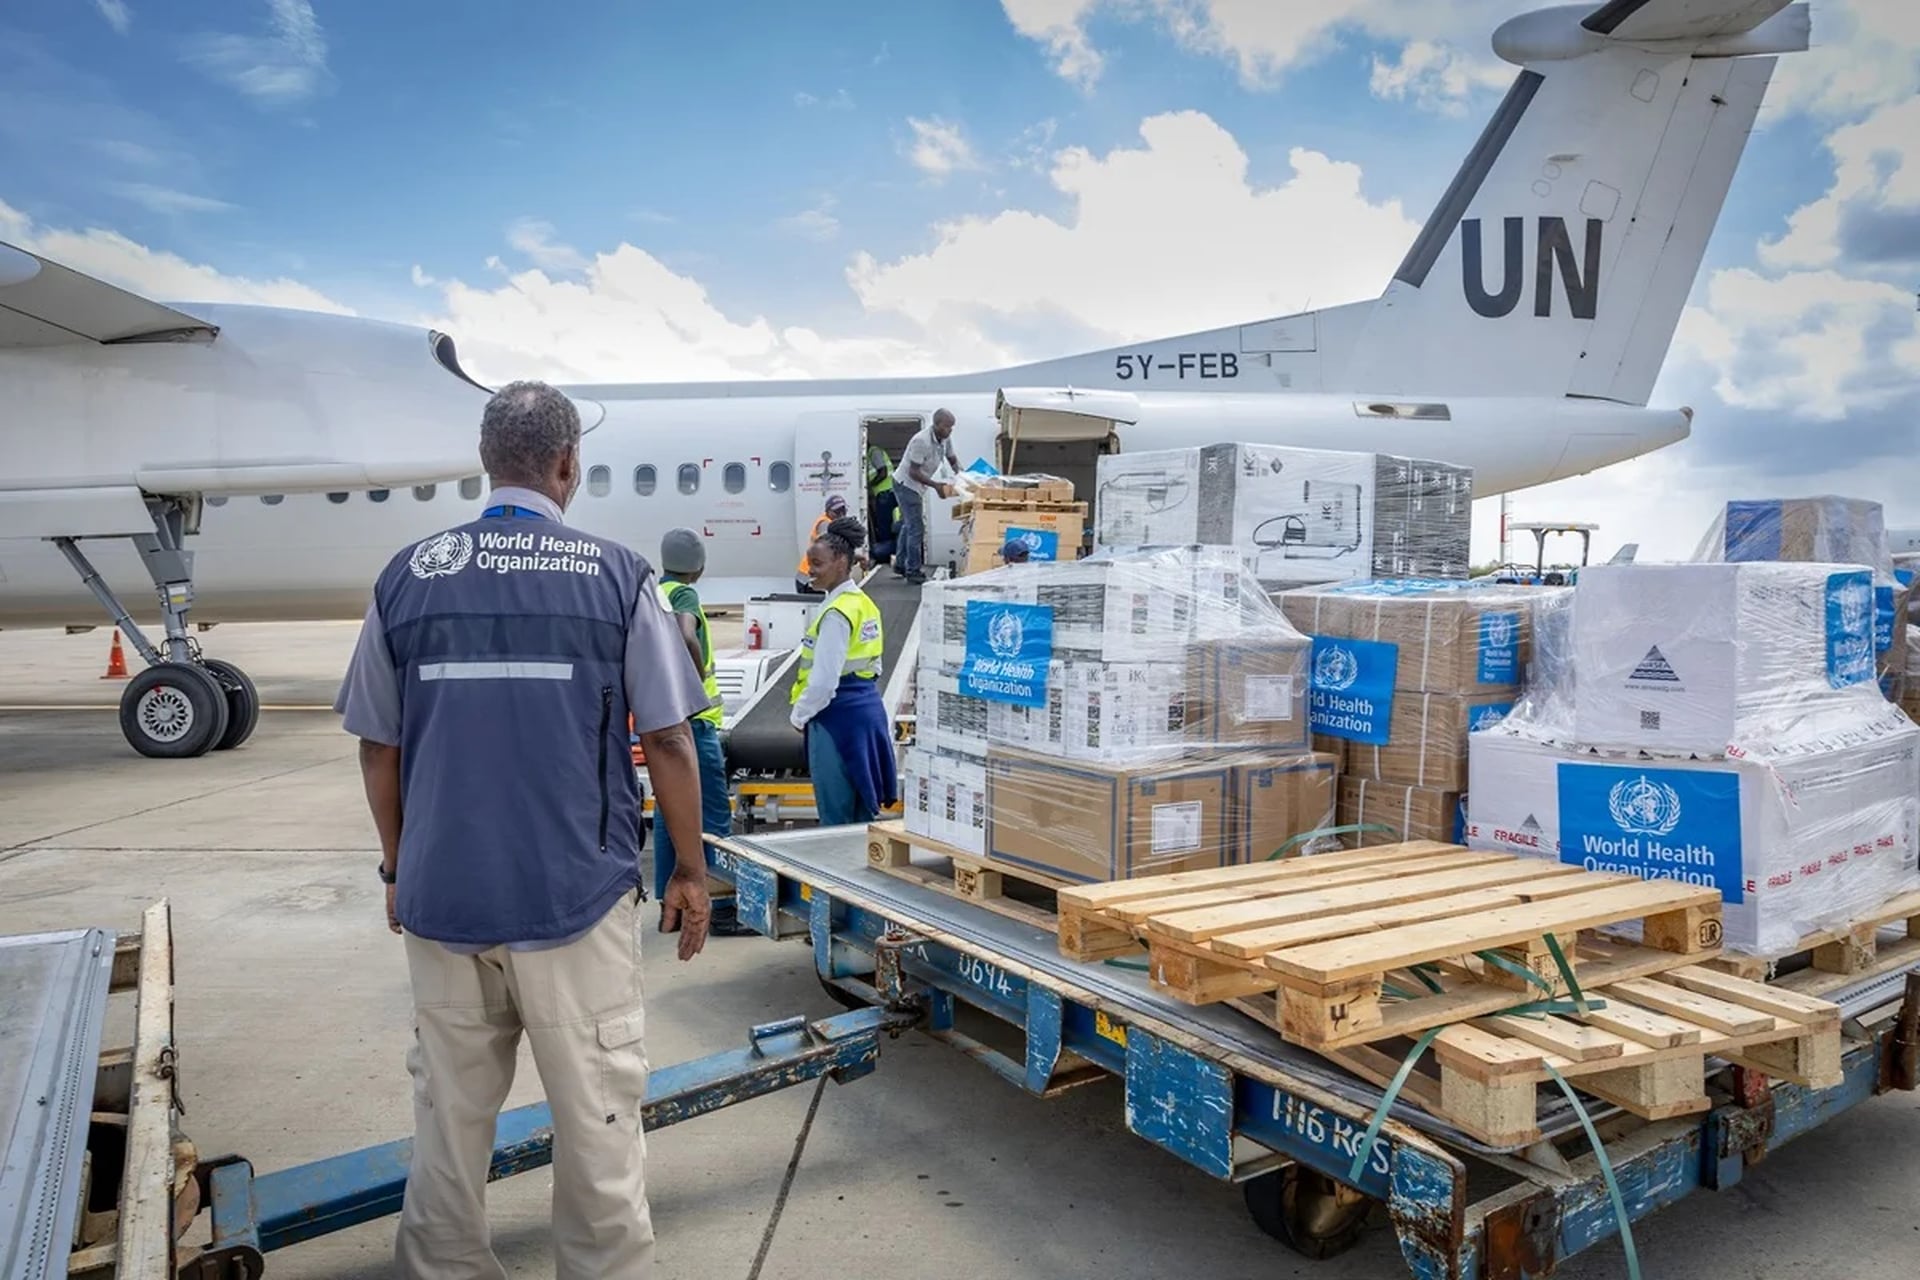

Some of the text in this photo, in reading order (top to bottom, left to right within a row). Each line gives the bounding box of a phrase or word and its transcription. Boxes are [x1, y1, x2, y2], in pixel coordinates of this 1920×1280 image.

[1461, 216, 1603, 320] UN
[1116, 352, 1240, 380] 5Y-FEB
[479, 532, 602, 558] World Health
[476, 550, 600, 575] Organization
[1000, 661, 1035, 680] Health
[968, 672, 1033, 697] Organization
[1329, 694, 1374, 716] Health
[1308, 710, 1373, 733] anization
[1494, 829, 1539, 848] FRAGILE
[1583, 834, 1715, 867] World Health
